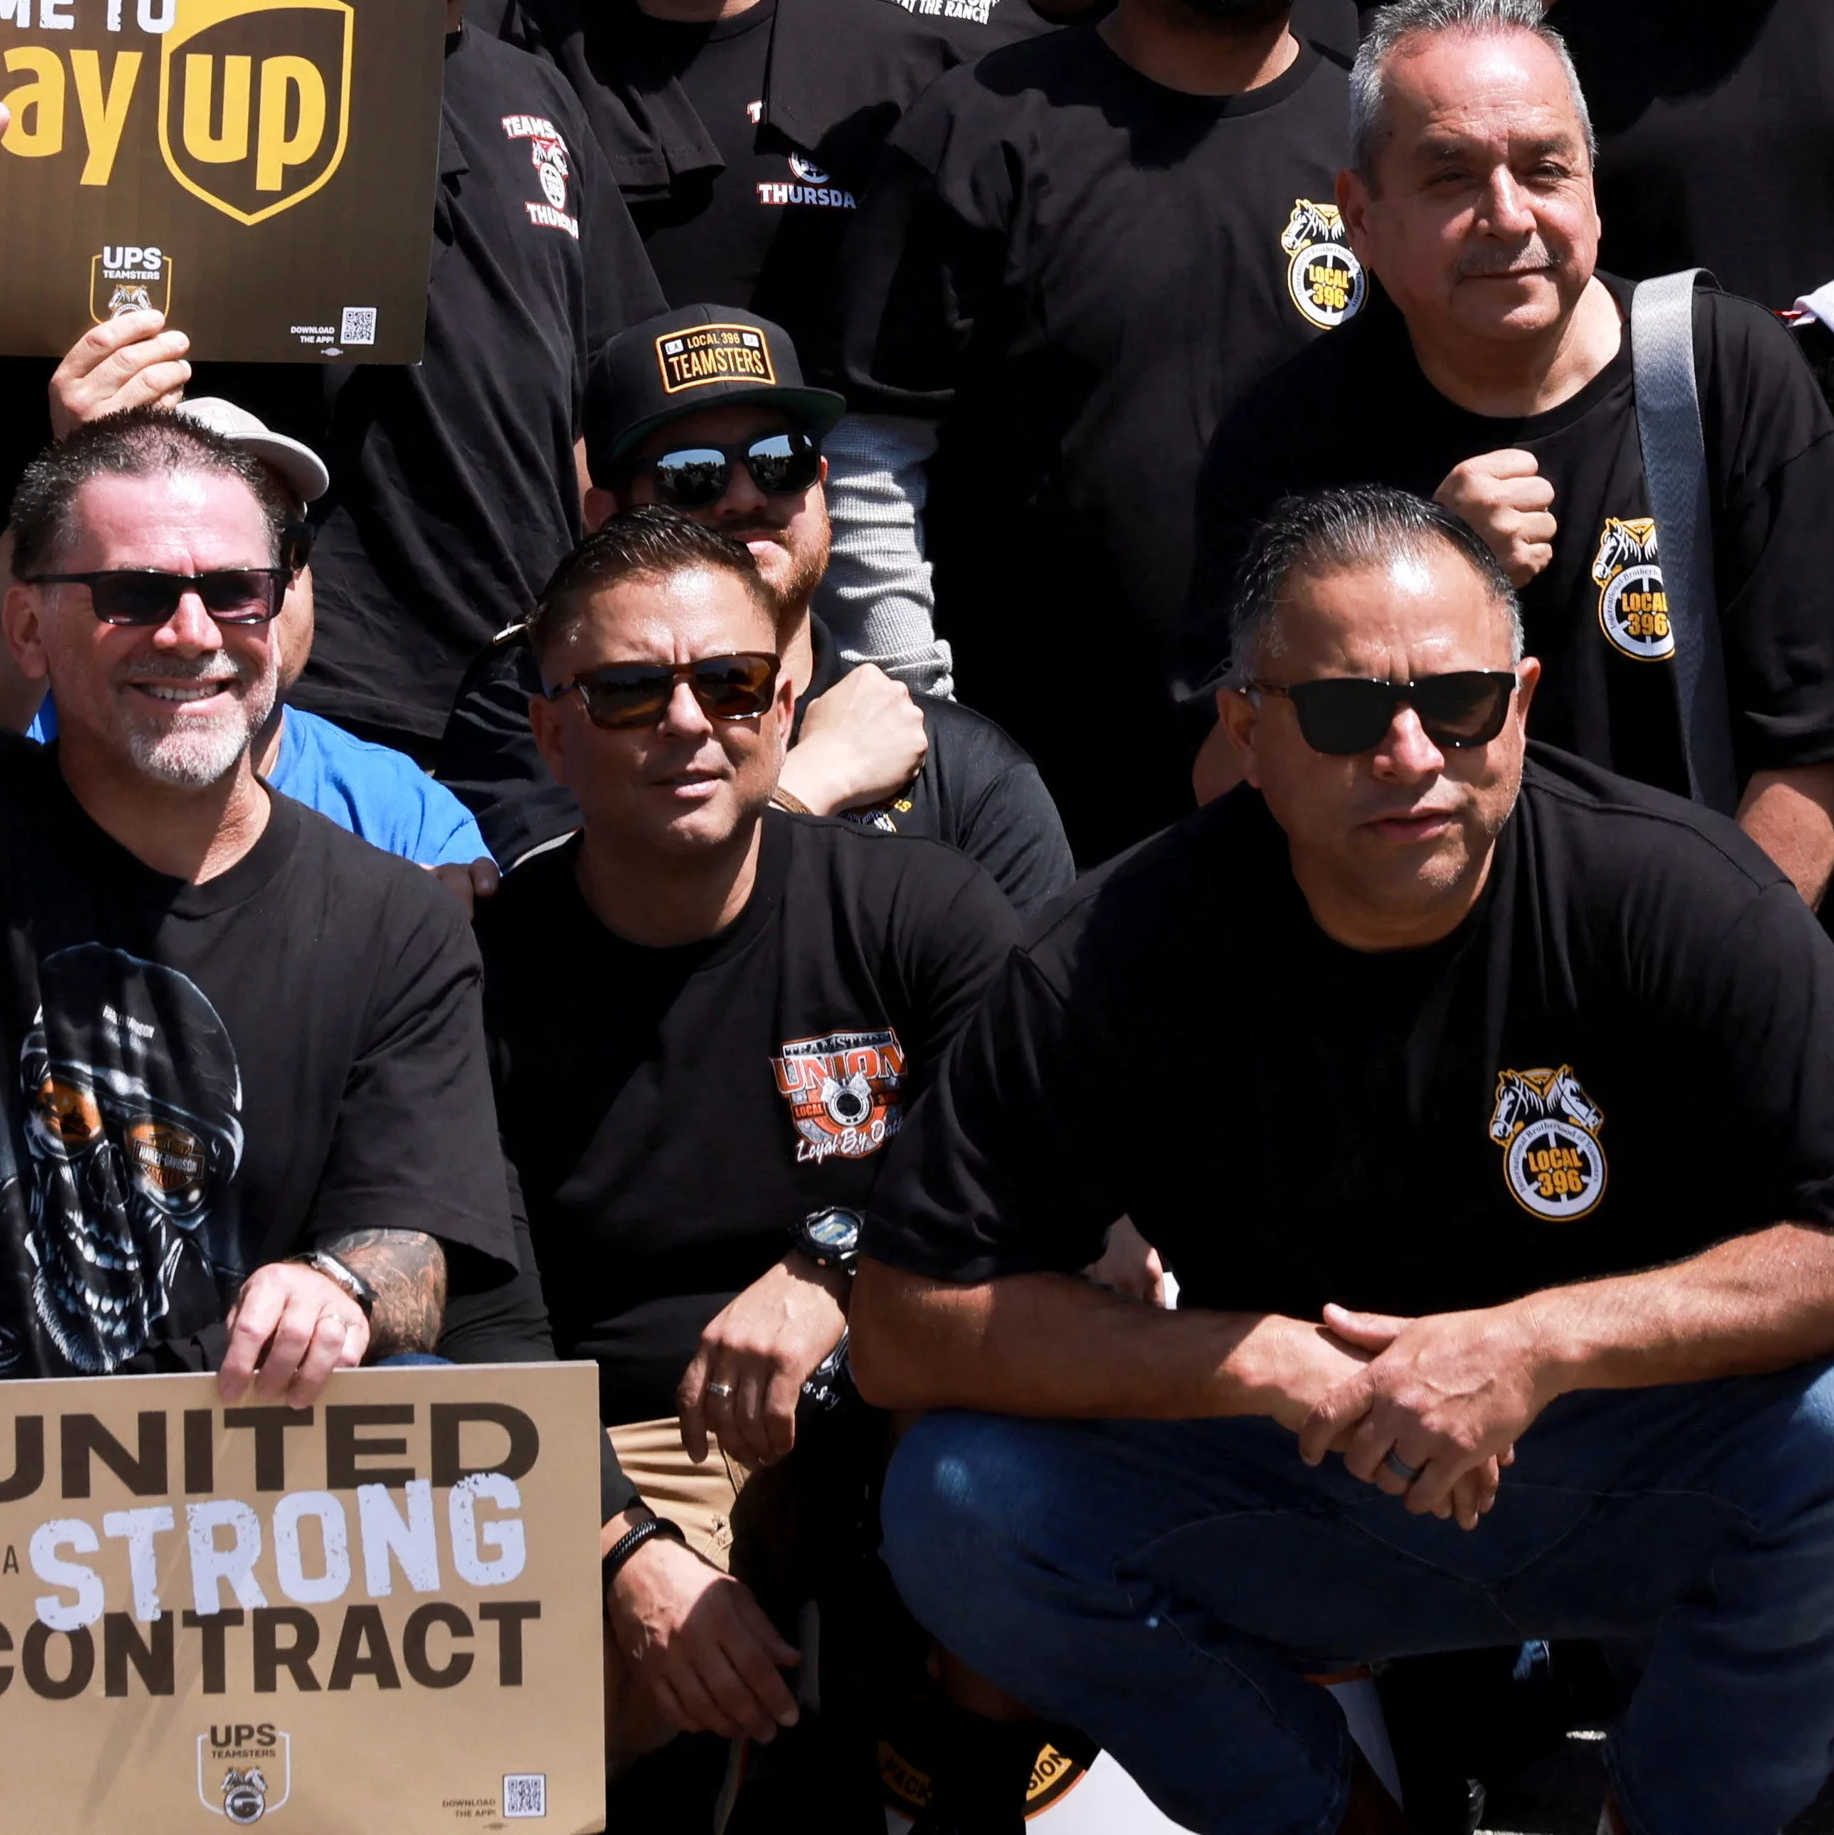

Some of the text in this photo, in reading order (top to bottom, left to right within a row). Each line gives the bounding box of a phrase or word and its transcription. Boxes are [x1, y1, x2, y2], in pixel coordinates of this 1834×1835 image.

[945, 1, 989, 25] RANCH
[184, 54, 326, 191] up
[757, 183, 857, 209] THURSDA
[103, 246, 161, 270] UPS
[103, 270, 160, 281] TEAMSTERS
[1309, 265, 1349, 288] LOCAL
[1312, 283, 1345, 309] 396
[290, 326, 335, 335] DOWNLOAD
[300, 336, 334, 344] THE APP!
[687, 335, 720, 349] LOCAL
[721, 332, 741, 344] 396
[669, 348, 765, 382] TEAMSTERS
[1621, 592, 1669, 612] LOCAL
[1627, 612, 1669, 637] 396
[769, 1046, 906, 1093] UNION
[794, 1104, 825, 1118] LOCAL
[797, 1133, 838, 1164] Loyal
[841, 1127, 867, 1154] By
[1528, 1147, 1583, 1172] LOCAL
[1538, 1169, 1583, 1197] 396
[3, 1545, 19, 1574] A
[29, 1472, 526, 1631] STRONG
[210, 1723, 276, 1747] UPS
[212, 1748, 276, 1759] TEAMSTERS
[442, 1798, 496, 1808] DOWNLOAD
[455, 1810, 472, 1818] THE
